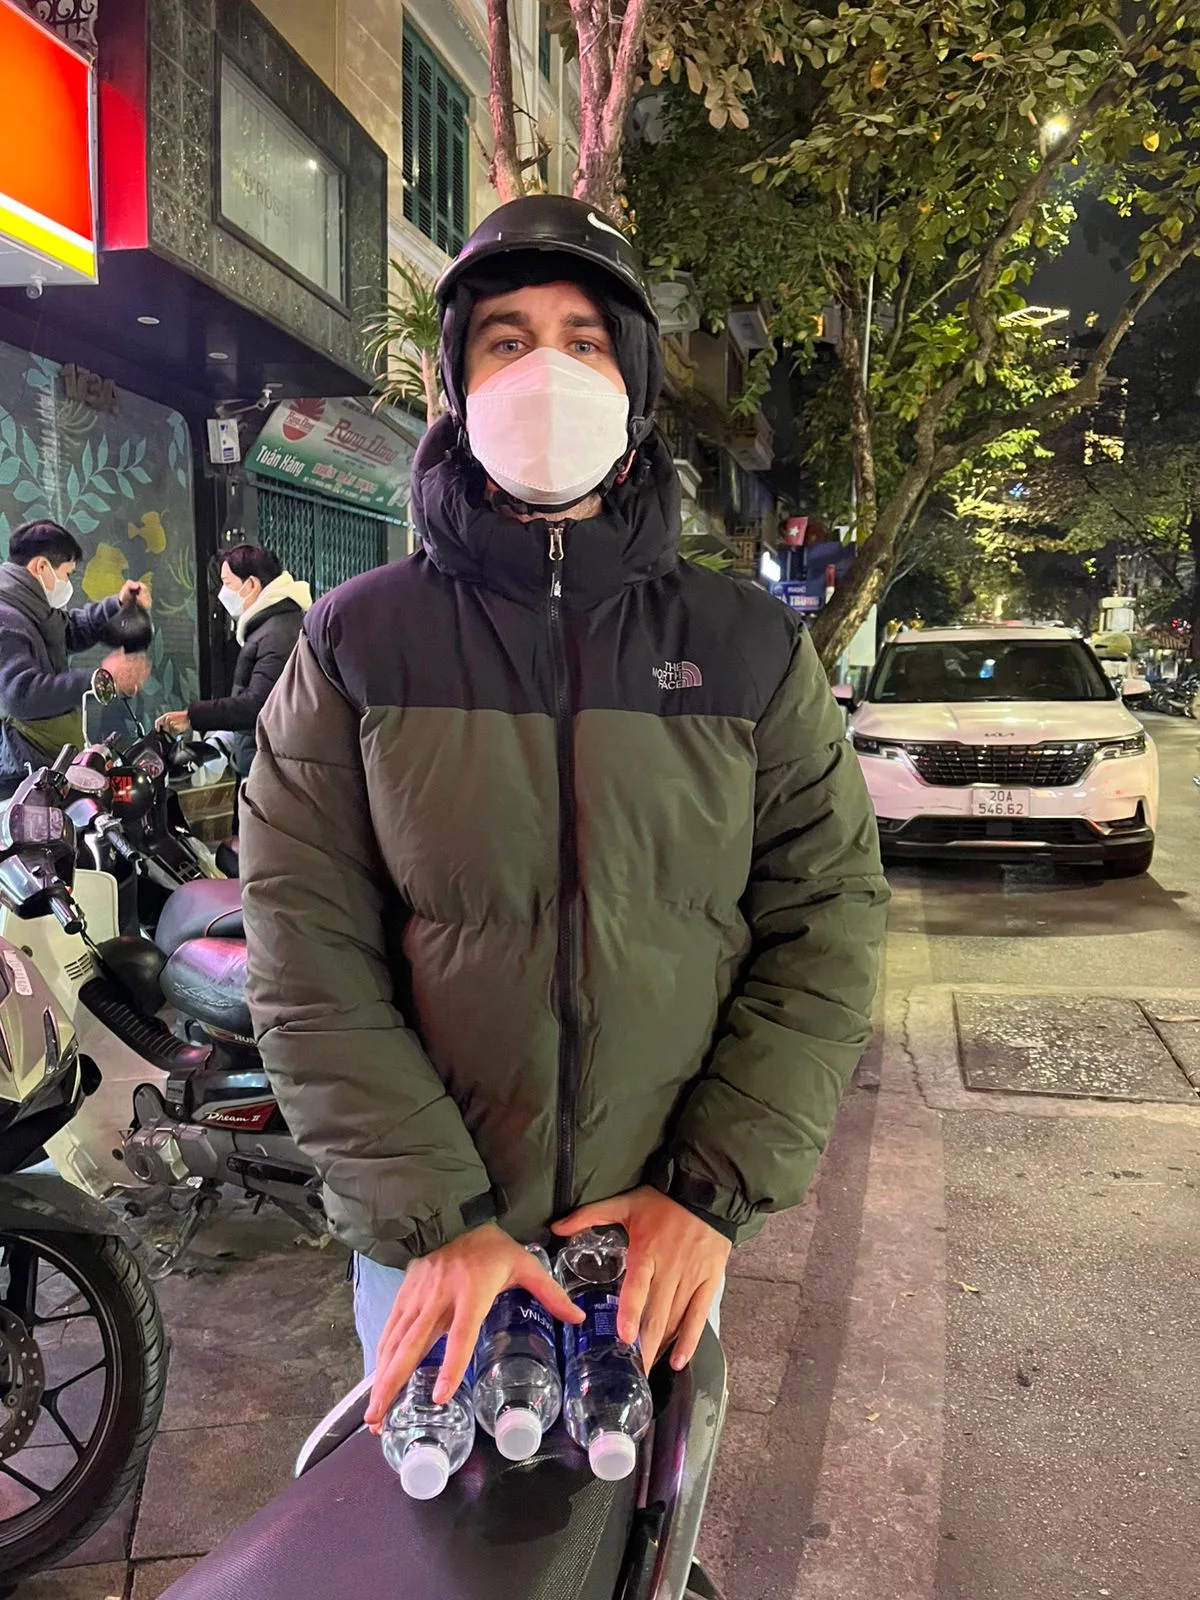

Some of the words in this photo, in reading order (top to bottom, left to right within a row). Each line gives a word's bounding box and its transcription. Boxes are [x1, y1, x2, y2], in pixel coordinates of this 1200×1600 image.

[256, 445, 281, 468] Tuấn
[664, 661, 682, 671] THE
[652, 667, 682, 680] NORTH
[658, 679, 682, 690] FACE
[989, 790, 1013, 802] 20A
[978, 803, 1024, 815] 546.62
[205, 1112, 249, 1122] Dream
